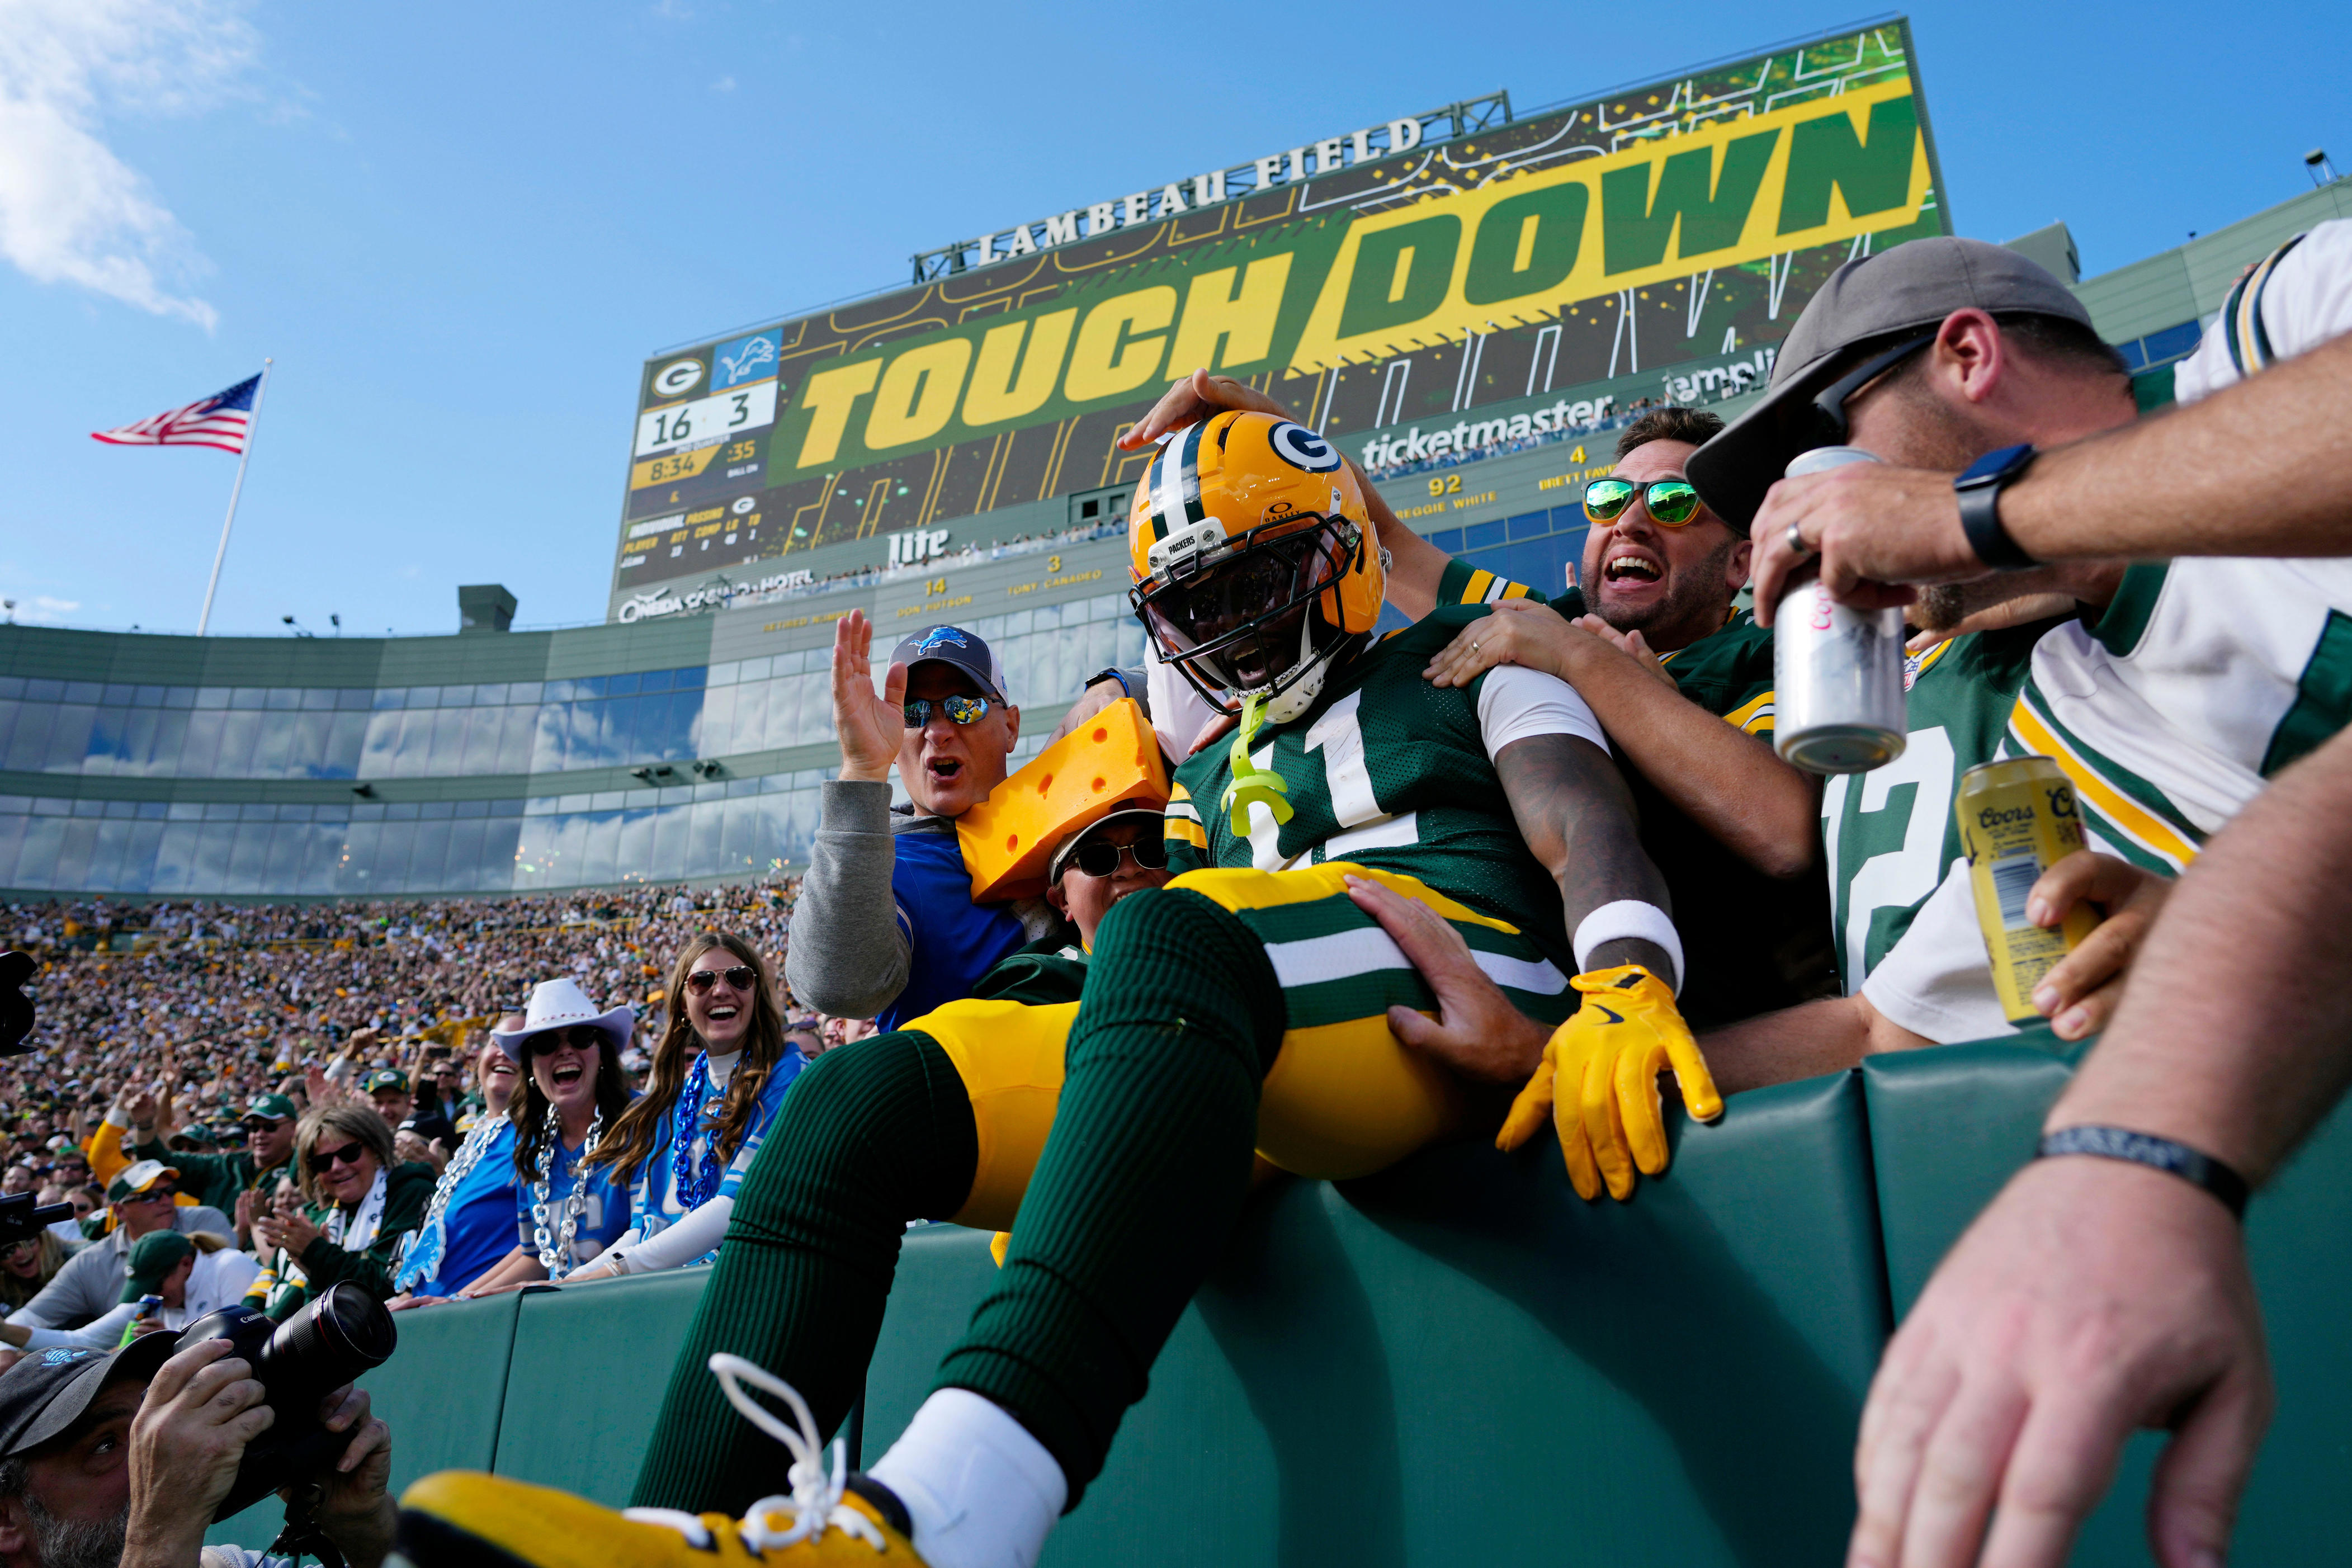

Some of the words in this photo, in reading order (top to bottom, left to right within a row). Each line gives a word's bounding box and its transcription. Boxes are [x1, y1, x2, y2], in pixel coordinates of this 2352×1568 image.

[977, 169, 1228, 267] LAMBEAU
[1255, 117, 1423, 191] FIELD
[797, 252, 1294, 470] TOUCH
[1334, 93, 1919, 341] DOWN
[653, 408, 691, 446] 16
[729, 393, 749, 427] 3
[1362, 395, 1614, 470] ticketmaster
[1570, 445, 1587, 464] 4
[650, 455, 695, 481] 8:34
[1428, 474, 1462, 497] 92
[1539, 471, 1581, 491] BRETT
[1395, 501, 1446, 519] REGGIE
[1453, 490, 1497, 509] WHITE
[887, 528, 949, 570] lite
[1168, 535, 1196, 555] PACKERS
[1047, 555, 1061, 573] 3
[924, 577, 947, 597] 14
[1008, 582, 1038, 596] TONY
[1043, 569, 1102, 589] CANADEO
[618, 595, 683, 624] ONEIDA
[897, 605, 921, 618] DON
[925, 594, 973, 612] HUTSON
[763, 617, 808, 633] RETIRED
[1978, 807, 2034, 829] Coors
[240, 1312, 265, 1324] Canon
